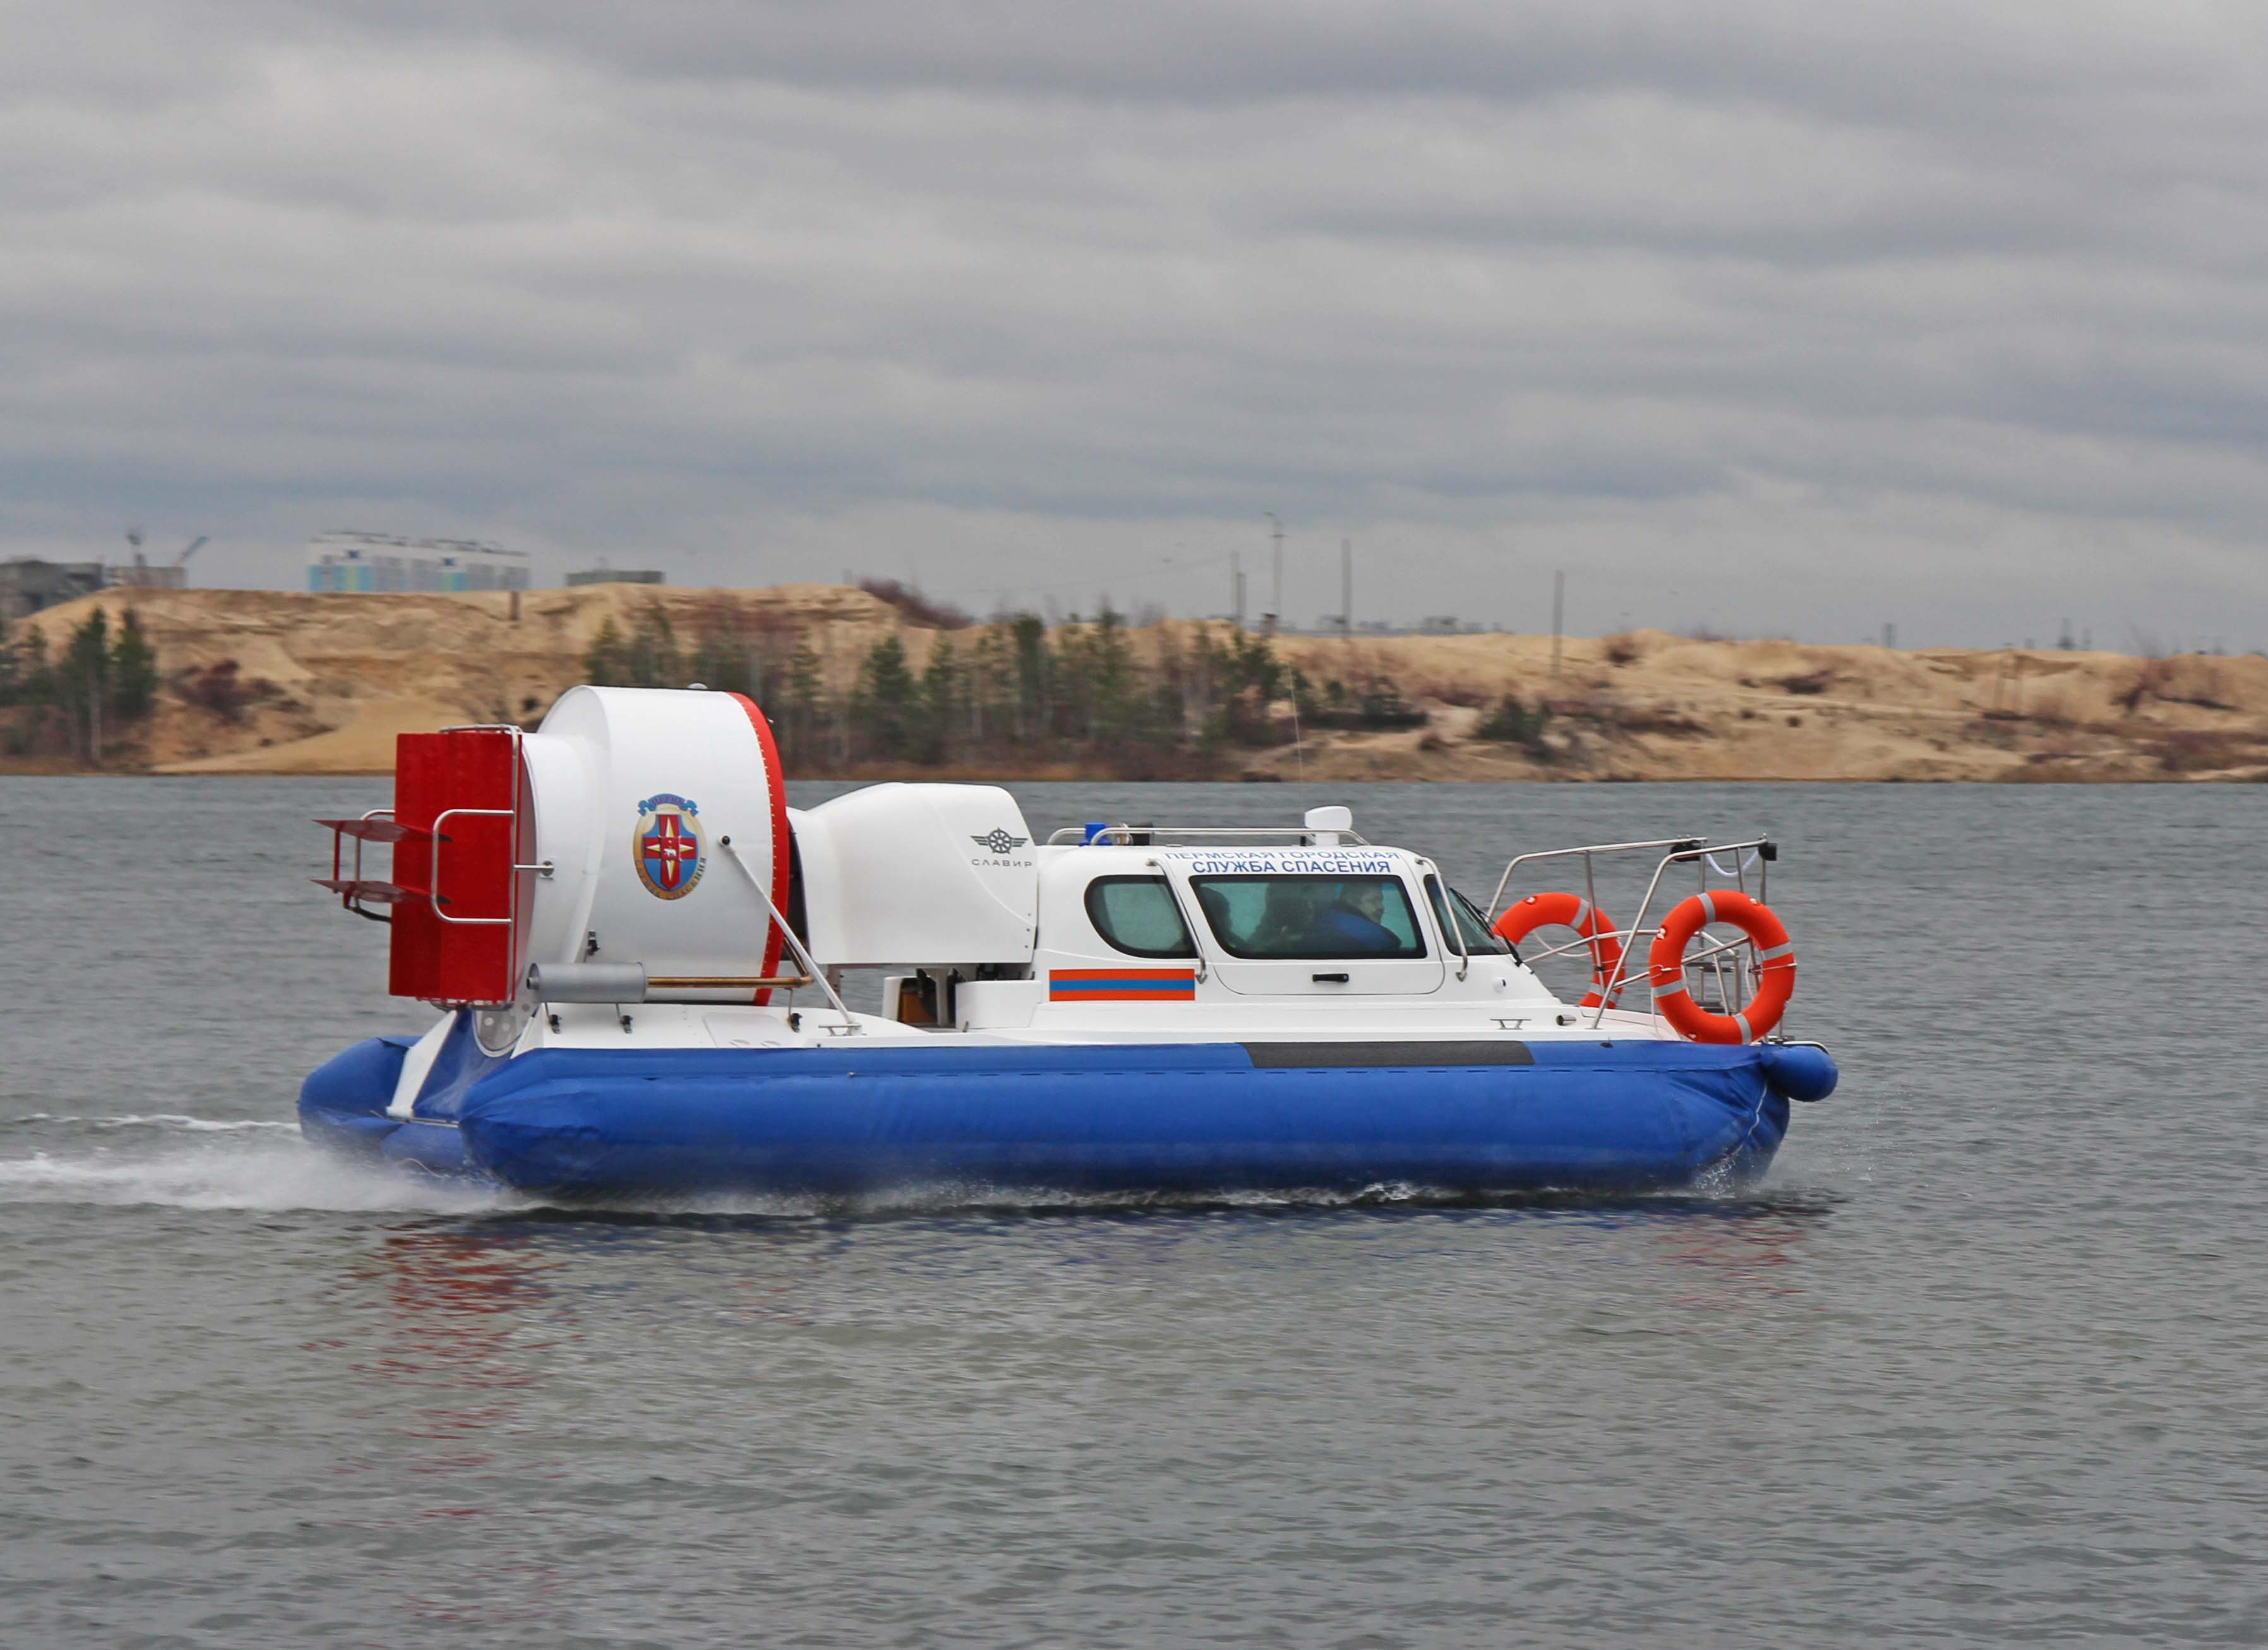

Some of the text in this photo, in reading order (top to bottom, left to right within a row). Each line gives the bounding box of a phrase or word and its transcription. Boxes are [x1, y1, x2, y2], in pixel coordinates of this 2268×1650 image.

[1279, 851, 1400, 859] ГОРОДСКАЯ
[971, 859, 1032, 868] СЛАВИР
[1192, 861, 1391, 873] СЛУЖБА СПАСЕНИЯ
